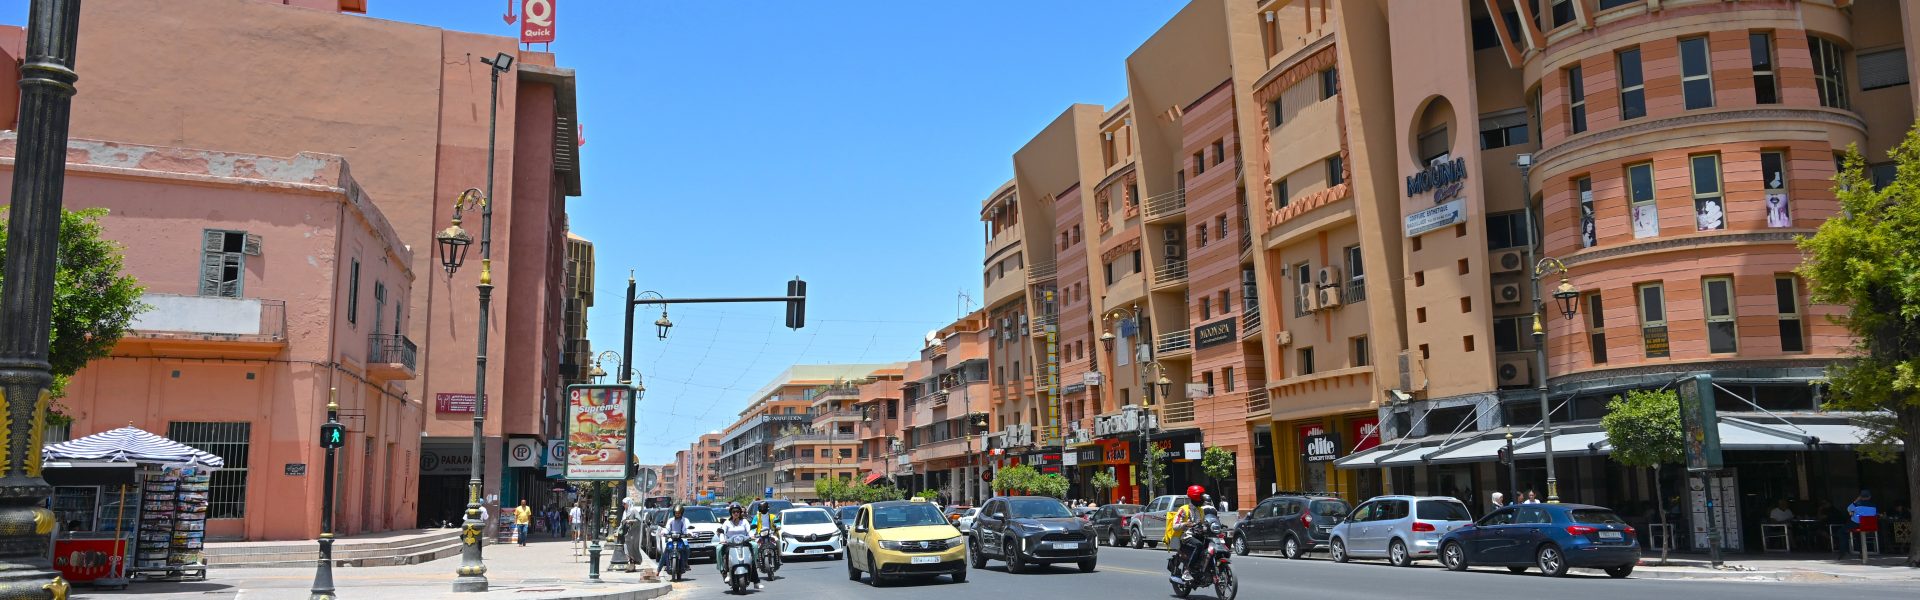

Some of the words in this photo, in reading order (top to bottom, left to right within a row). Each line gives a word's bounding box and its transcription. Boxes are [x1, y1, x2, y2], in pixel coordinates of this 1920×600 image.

[525, 0, 552, 27] Q
[525, 28, 551, 37] Quick
[1406, 157, 1467, 197] MOUNA
[1308, 436, 1334, 455] elite
[1082, 450, 1094, 461] ELITE
